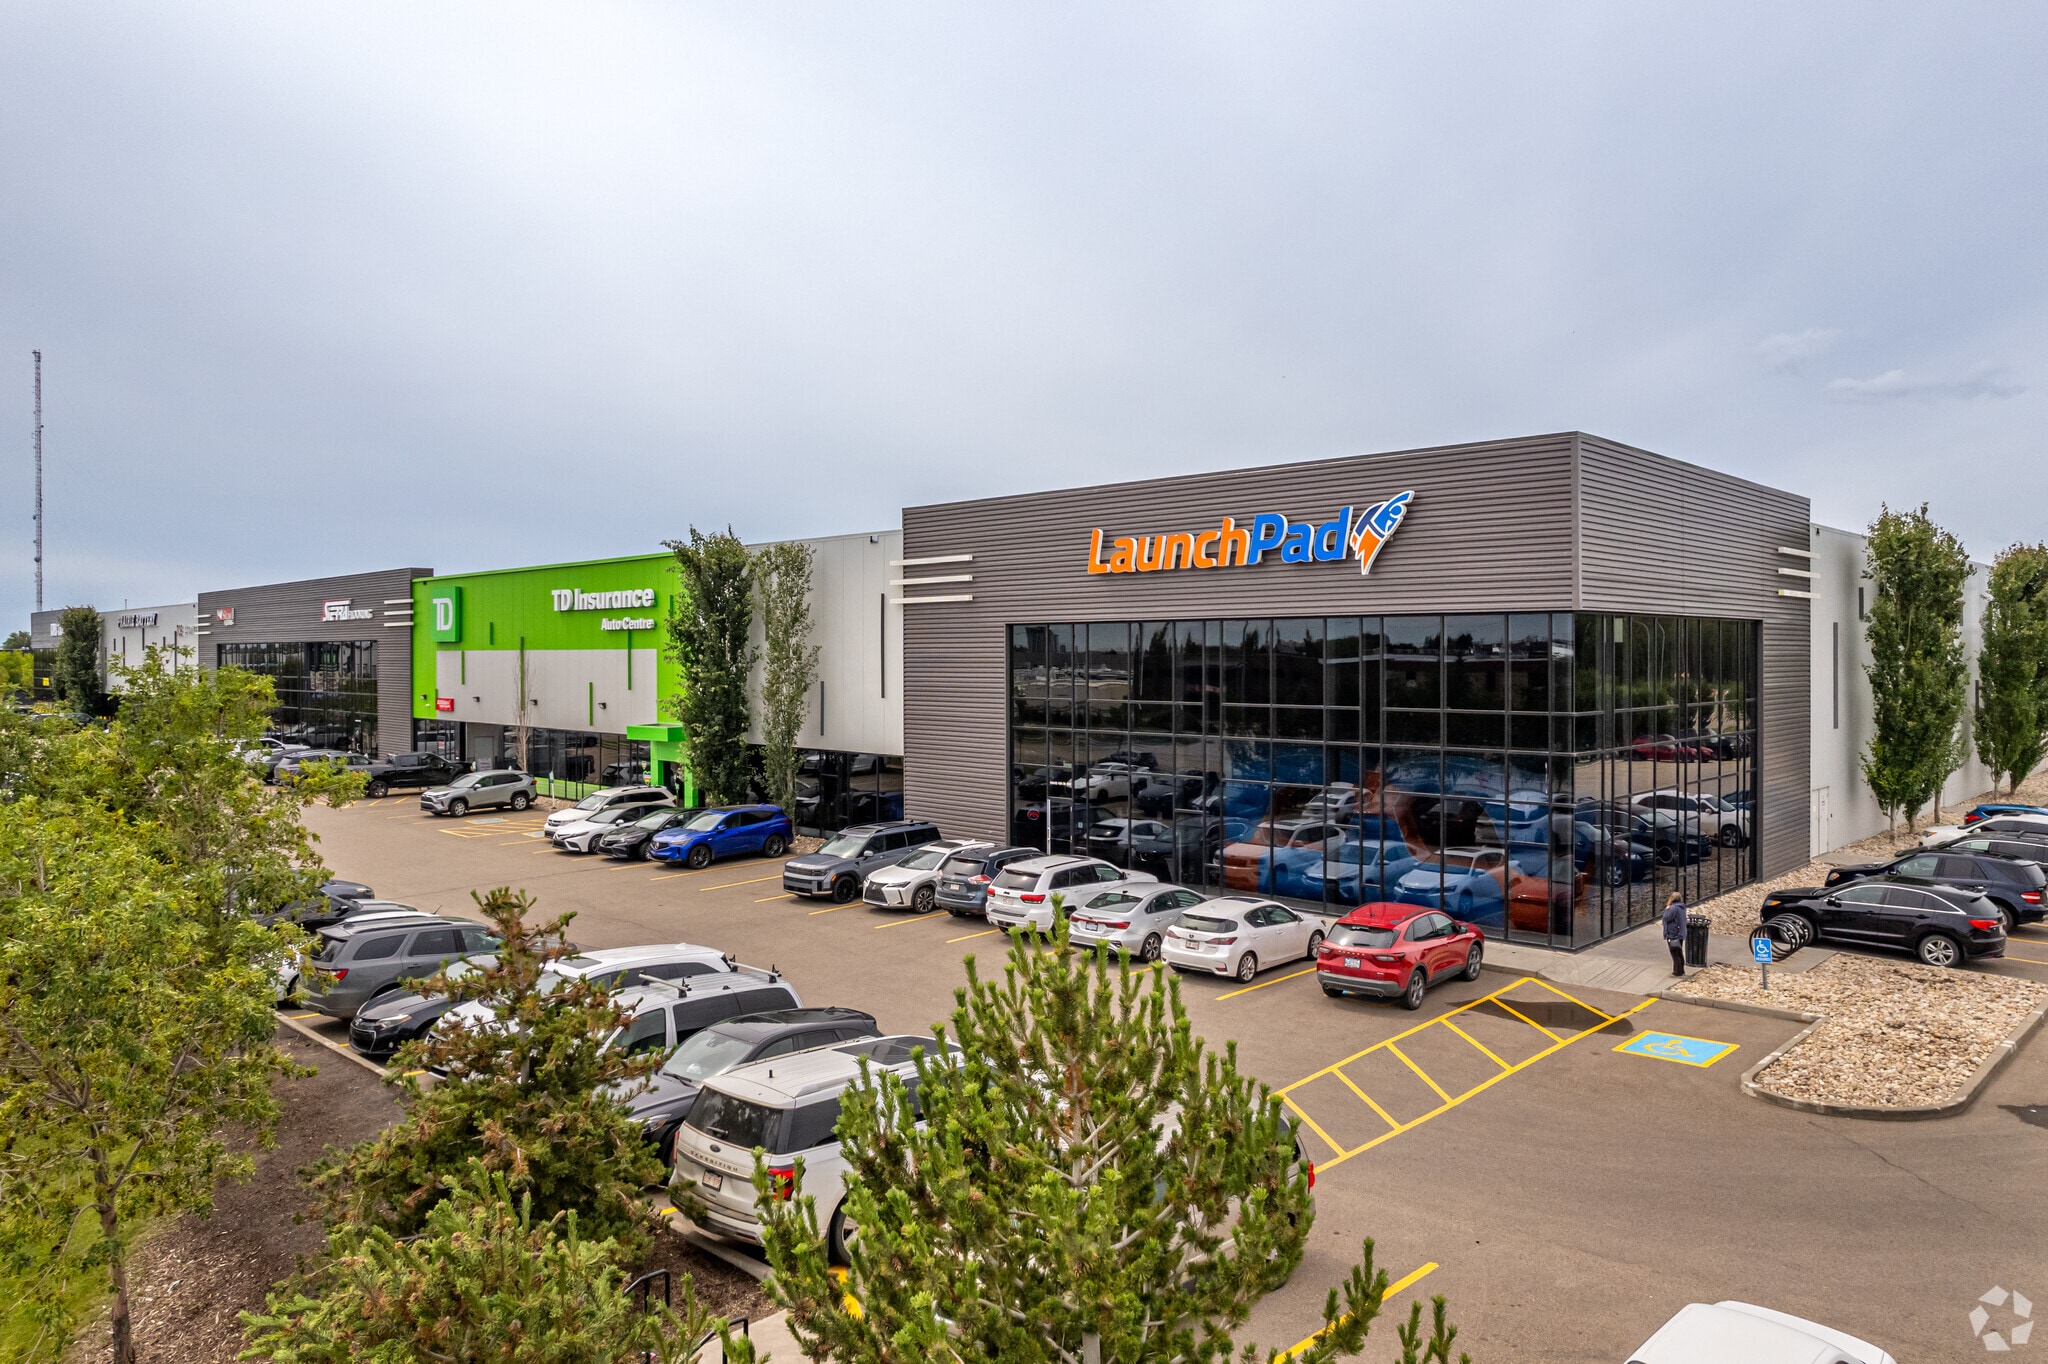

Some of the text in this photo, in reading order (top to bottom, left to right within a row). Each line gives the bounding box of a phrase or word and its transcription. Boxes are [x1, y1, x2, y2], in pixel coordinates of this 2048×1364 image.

[1087, 506, 1353, 574] LaunchPad
[432, 597, 454, 631] TD
[551, 588, 655, 612] TD Insurance
[601, 617, 655, 630] Auto Centre
